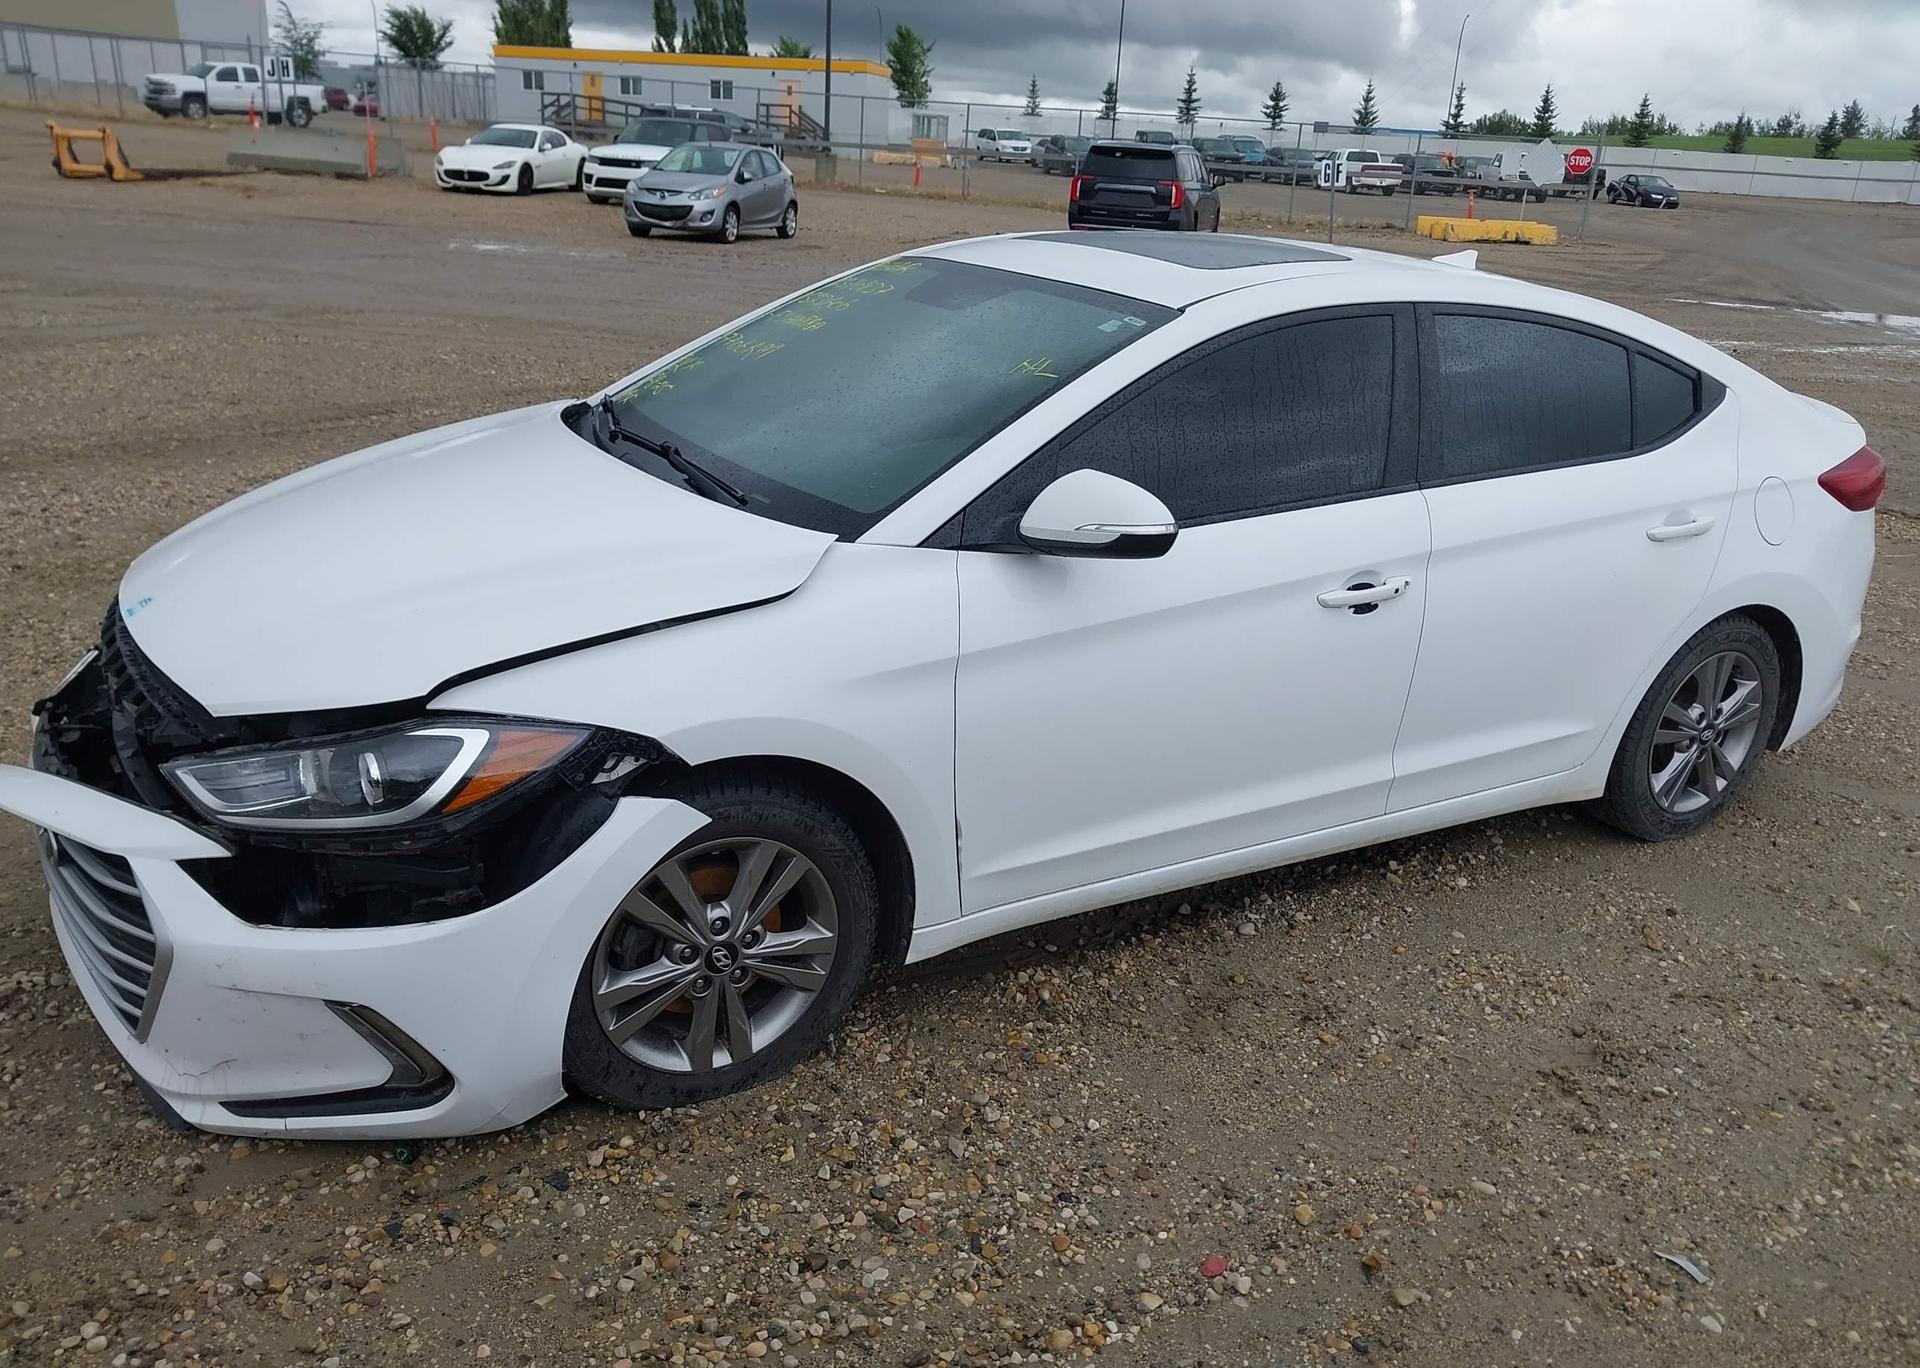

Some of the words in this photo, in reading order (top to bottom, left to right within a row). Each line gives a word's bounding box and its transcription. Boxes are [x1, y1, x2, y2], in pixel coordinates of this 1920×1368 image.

[267, 59, 275, 77] J
[281, 60, 290, 77] H
[1570, 155, 1591, 167] STOP
[1324, 163, 1331, 183] G
[1335, 163, 1343, 183] F
